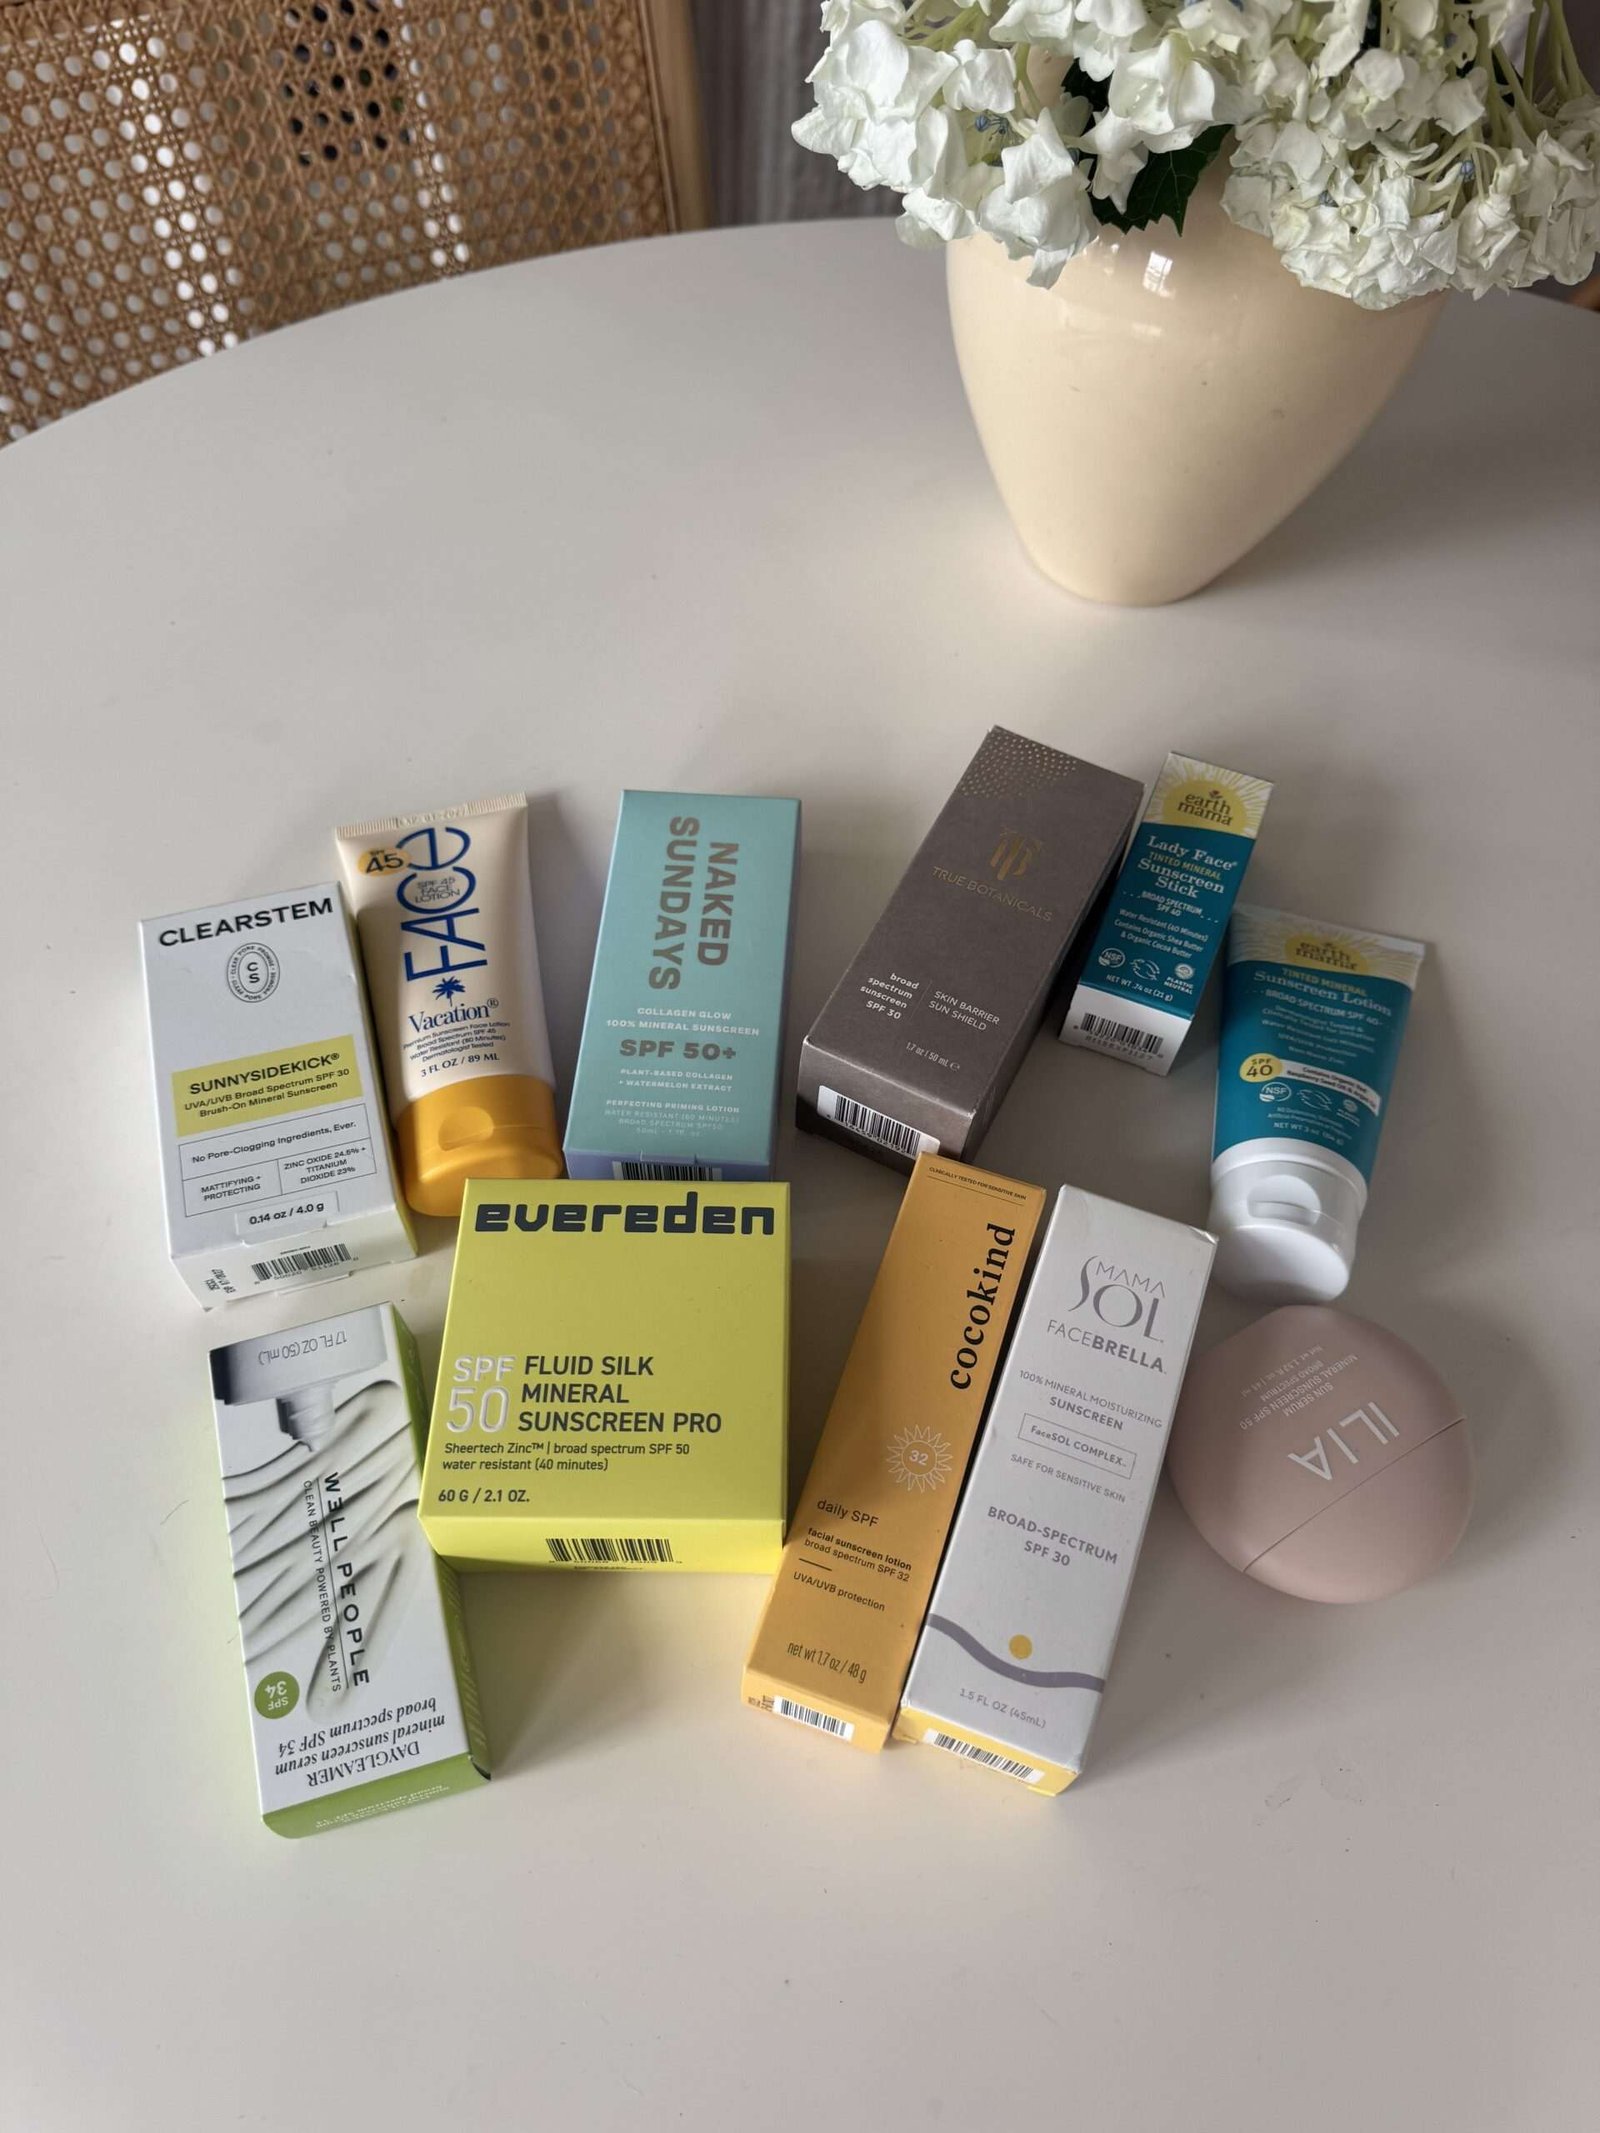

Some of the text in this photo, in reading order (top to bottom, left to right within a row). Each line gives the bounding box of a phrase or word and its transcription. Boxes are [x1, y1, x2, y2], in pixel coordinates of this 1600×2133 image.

[1177, 801, 1233, 825] mama
[1185, 792, 1231, 814] earth
[1147, 835, 1190, 857] Lady
[366, 853, 404, 874] 45
[1150, 852, 1181, 867] TINTED
[1137, 857, 1225, 894] Sunscreen
[1155, 876, 1199, 898] Stick
[648, 815, 700, 990] SUNDAYS
[697, 841, 739, 966] NAKED
[932, 866, 1053, 922] TRUE BOTANICALS
[1141, 891, 1166, 904] BROAD
[159, 897, 333, 947] CLEARSTEM
[1126, 933, 1171, 952] Organic Cocoa
[1105, 951, 1122, 962] NSF
[867, 976, 913, 1000] spectrum
[890, 972, 920, 990] broad
[1282, 968, 1320, 985] TINTED
[860, 984, 908, 1009] sunscreen
[1253, 970, 1393, 1017] Sunscreen Lotion
[1265, 989, 1297, 1004] BROAD
[637, 1007, 732, 1020] COLLAGEN GLOW
[865, 1000, 902, 1020] SPF 30
[928, 1001, 987, 1031] SUN SHIELD
[933, 990, 1000, 1025] SKIN BARRIER
[639, 1021, 760, 1036] MINERAL SUNSCREEN
[442, 1053, 500, 1068] OZ 89 ML
[619, 1038, 736, 1060] SPF 50+
[1246, 1064, 1273, 1077] 40
[1251, 1057, 1271, 1066] SPF
[185, 1068, 349, 1111] UVA/UVB Broad Spectrum SPF 30
[200, 1081, 338, 1118] Brush-On Mineral Sunscreen
[192, 1139, 276, 1163] No Pore-Clogging
[284, 1154, 332, 1170] ZINC OXIDE
[300, 1170, 335, 1184] DIOXIDE
[306, 1159, 347, 1173] TITANIUM
[201, 1176, 254, 1193] MATTIFYING
[204, 1184, 261, 1201] PROTECTING
[249, 1204, 314, 1225] 0.14 oz 4.0
[475, 1192, 775, 1235] evereden
[1096, 1261, 1165, 1298] MAMA
[950, 1223, 1016, 1390] cocokind
[302, 1334, 333, 1354] FL OZ
[453, 1355, 516, 1382] SPF
[524, 1355, 654, 1376] FLUID SILK
[521, 1384, 630, 1404] MINERAL
[1020, 1370, 1163, 1428] 100% MINERAL MOISTURIZING
[1270, 1375, 1321, 1411] SUNSCREEN
[1283, 1382, 1333, 1416] SUN SERUM
[446, 1385, 511, 1433] 50
[1049, 1396, 1124, 1431] SUNSCREEN
[1254, 1407, 1270, 1423] SPF
[518, 1412, 722, 1433] SUNSCREEN PRO
[1240, 1418, 1253, 1429] 50
[1030, 1425, 1071, 1447] FaceSOL
[1287, 1401, 1400, 1481] ILIA
[445, 1443, 504, 1454] Sheertech
[554, 1443, 588, 1454] broad
[591, 1444, 646, 1457] spectrum
[649, 1443, 673, 1454] SPF
[676, 1443, 690, 1455] 50
[909, 1450, 928, 1465] 32
[442, 1458, 609, 1471] water resistant (40 minutes)
[1010, 1453, 1126, 1503] SAFE FOR SENSITIVE SKIN
[439, 1489, 530, 1503] 60 G 2.1 OZ.
[817, 1499, 879, 1527] daily SPF
[987, 1506, 1118, 1565] BROAD-SPECTRUM
[804, 1539, 910, 1582] broad spectrum SPF 32
[808, 1527, 912, 1570] facial sunscreen lotion
[1024, 1540, 1071, 1567] SPF 30
[303, 1480, 341, 1692] CLEAN BEAUTY POWERED BY PLANTS
[793, 1571, 885, 1611] UVA/UVB protection
[337, 1562, 370, 1687] PEOPLE
[787, 1642, 860, 1678] net wt oz 48
[265, 1680, 287, 1698] 34
[959, 1688, 1009, 1713] 1.5 FL OZ
[267, 1696, 289, 1711] SPF
[278, 1697, 436, 1758] broad spectrum SPF 34
[275, 1715, 445, 1775] mineral sunscreen serum
[307, 1741, 421, 1787] DAYGLEAMER
